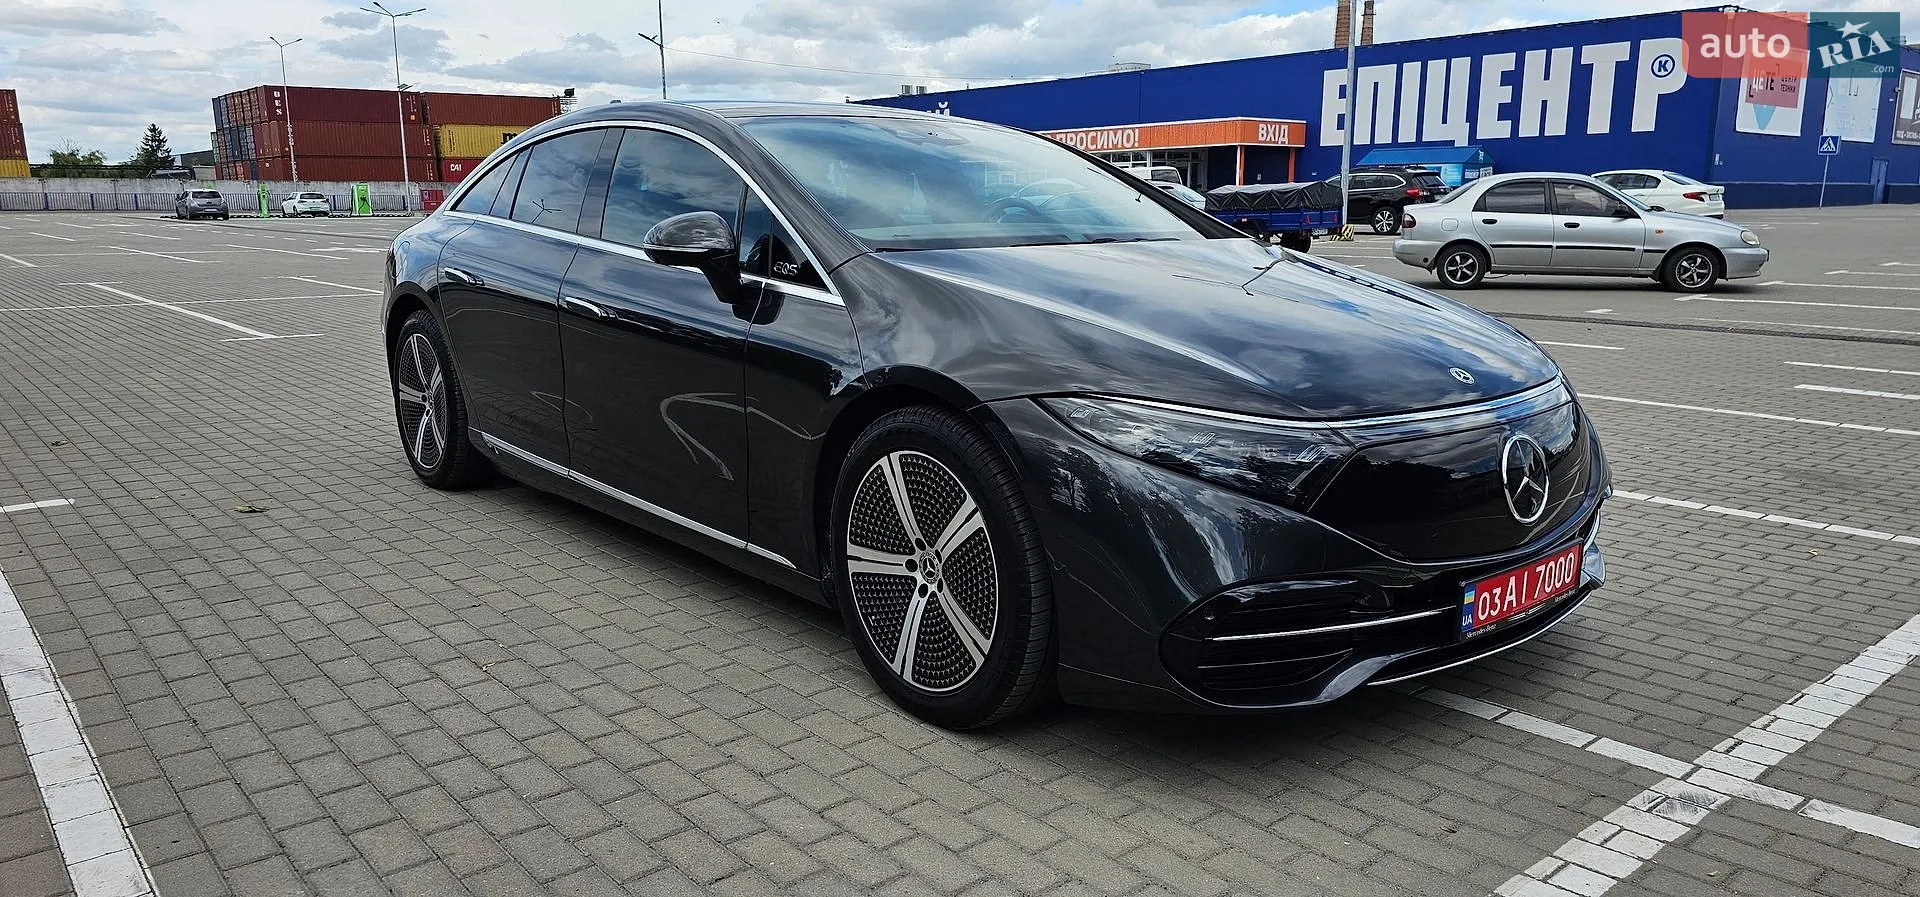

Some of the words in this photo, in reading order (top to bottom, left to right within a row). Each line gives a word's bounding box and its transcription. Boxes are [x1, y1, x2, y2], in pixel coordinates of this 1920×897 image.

[1319, 37, 1690, 148] ЕПІЦЕНТР
[1258, 123, 1289, 145] ВХІД
[773, 261, 798, 276] EQS
[1461, 613, 1473, 627] UA
